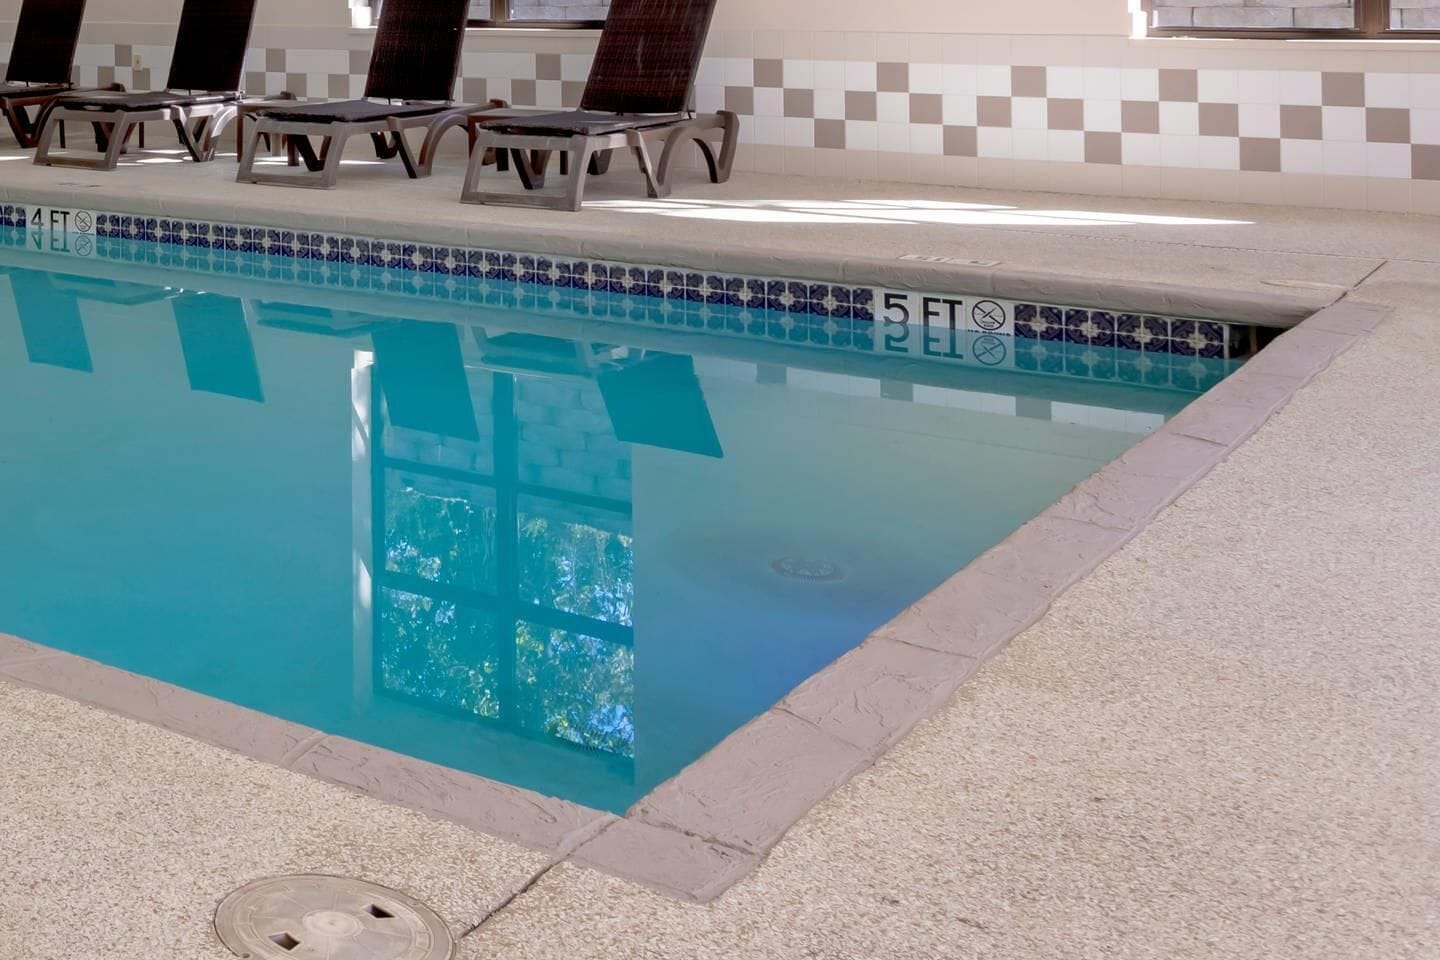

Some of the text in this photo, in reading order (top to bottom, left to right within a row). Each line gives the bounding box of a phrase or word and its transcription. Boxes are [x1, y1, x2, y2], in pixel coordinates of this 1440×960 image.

[30, 208, 70, 231] 4 FT
[884, 293, 963, 330] 5 FT
